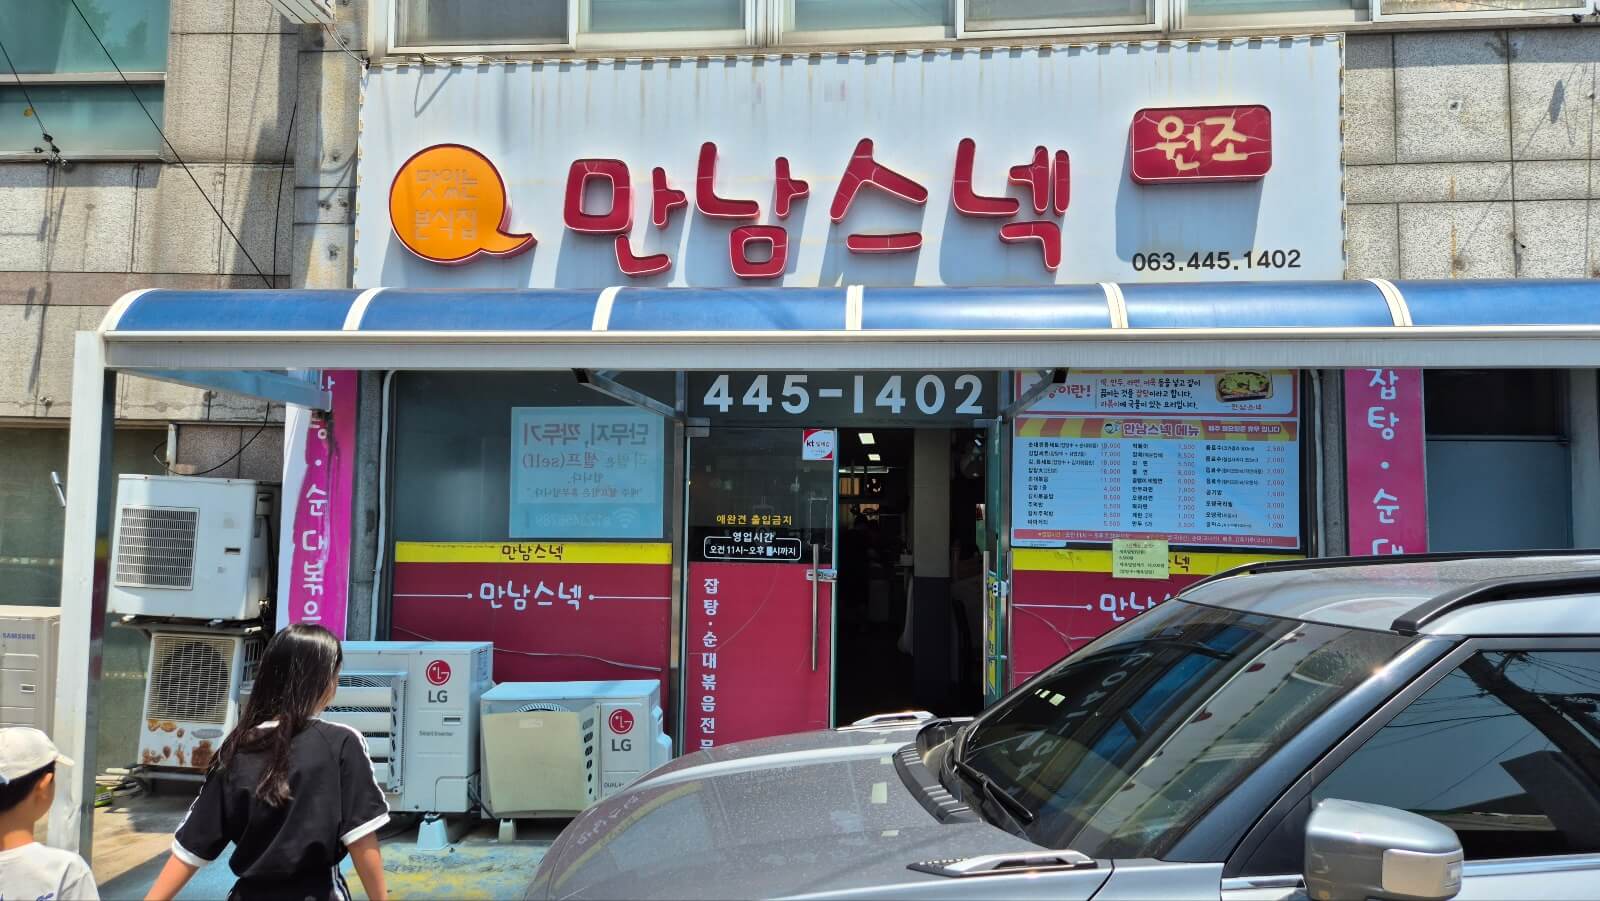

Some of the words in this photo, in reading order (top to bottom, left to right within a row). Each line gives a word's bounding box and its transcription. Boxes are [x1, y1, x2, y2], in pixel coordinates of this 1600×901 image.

[1156, 113, 1247, 173] 원조
[416, 168, 479, 207] 맛있는
[563, 137, 1071, 278] 만남스넥
[415, 215, 479, 248] 분식집
[1132, 250, 1302, 276] 063.445.1402
[703, 374, 985, 416] 445-1402
[1123, 422, 1173, 437] 만남스넥
[1174, 422, 1201, 437] 메뉴
[806, 439, 816, 448] kt
[716, 514, 748, 526] 애완견
[751, 514, 792, 526] 출입금지
[732, 532, 775, 543] 영업시간
[502, 543, 564, 562] 만남스넥
[709, 546, 725, 555] 오전
[478, 579, 583, 611] 만남스넥
[2, 632, 37, 641] SAMSUNG
[427, 690, 449, 704] LG
[611, 738, 633, 753] LG
